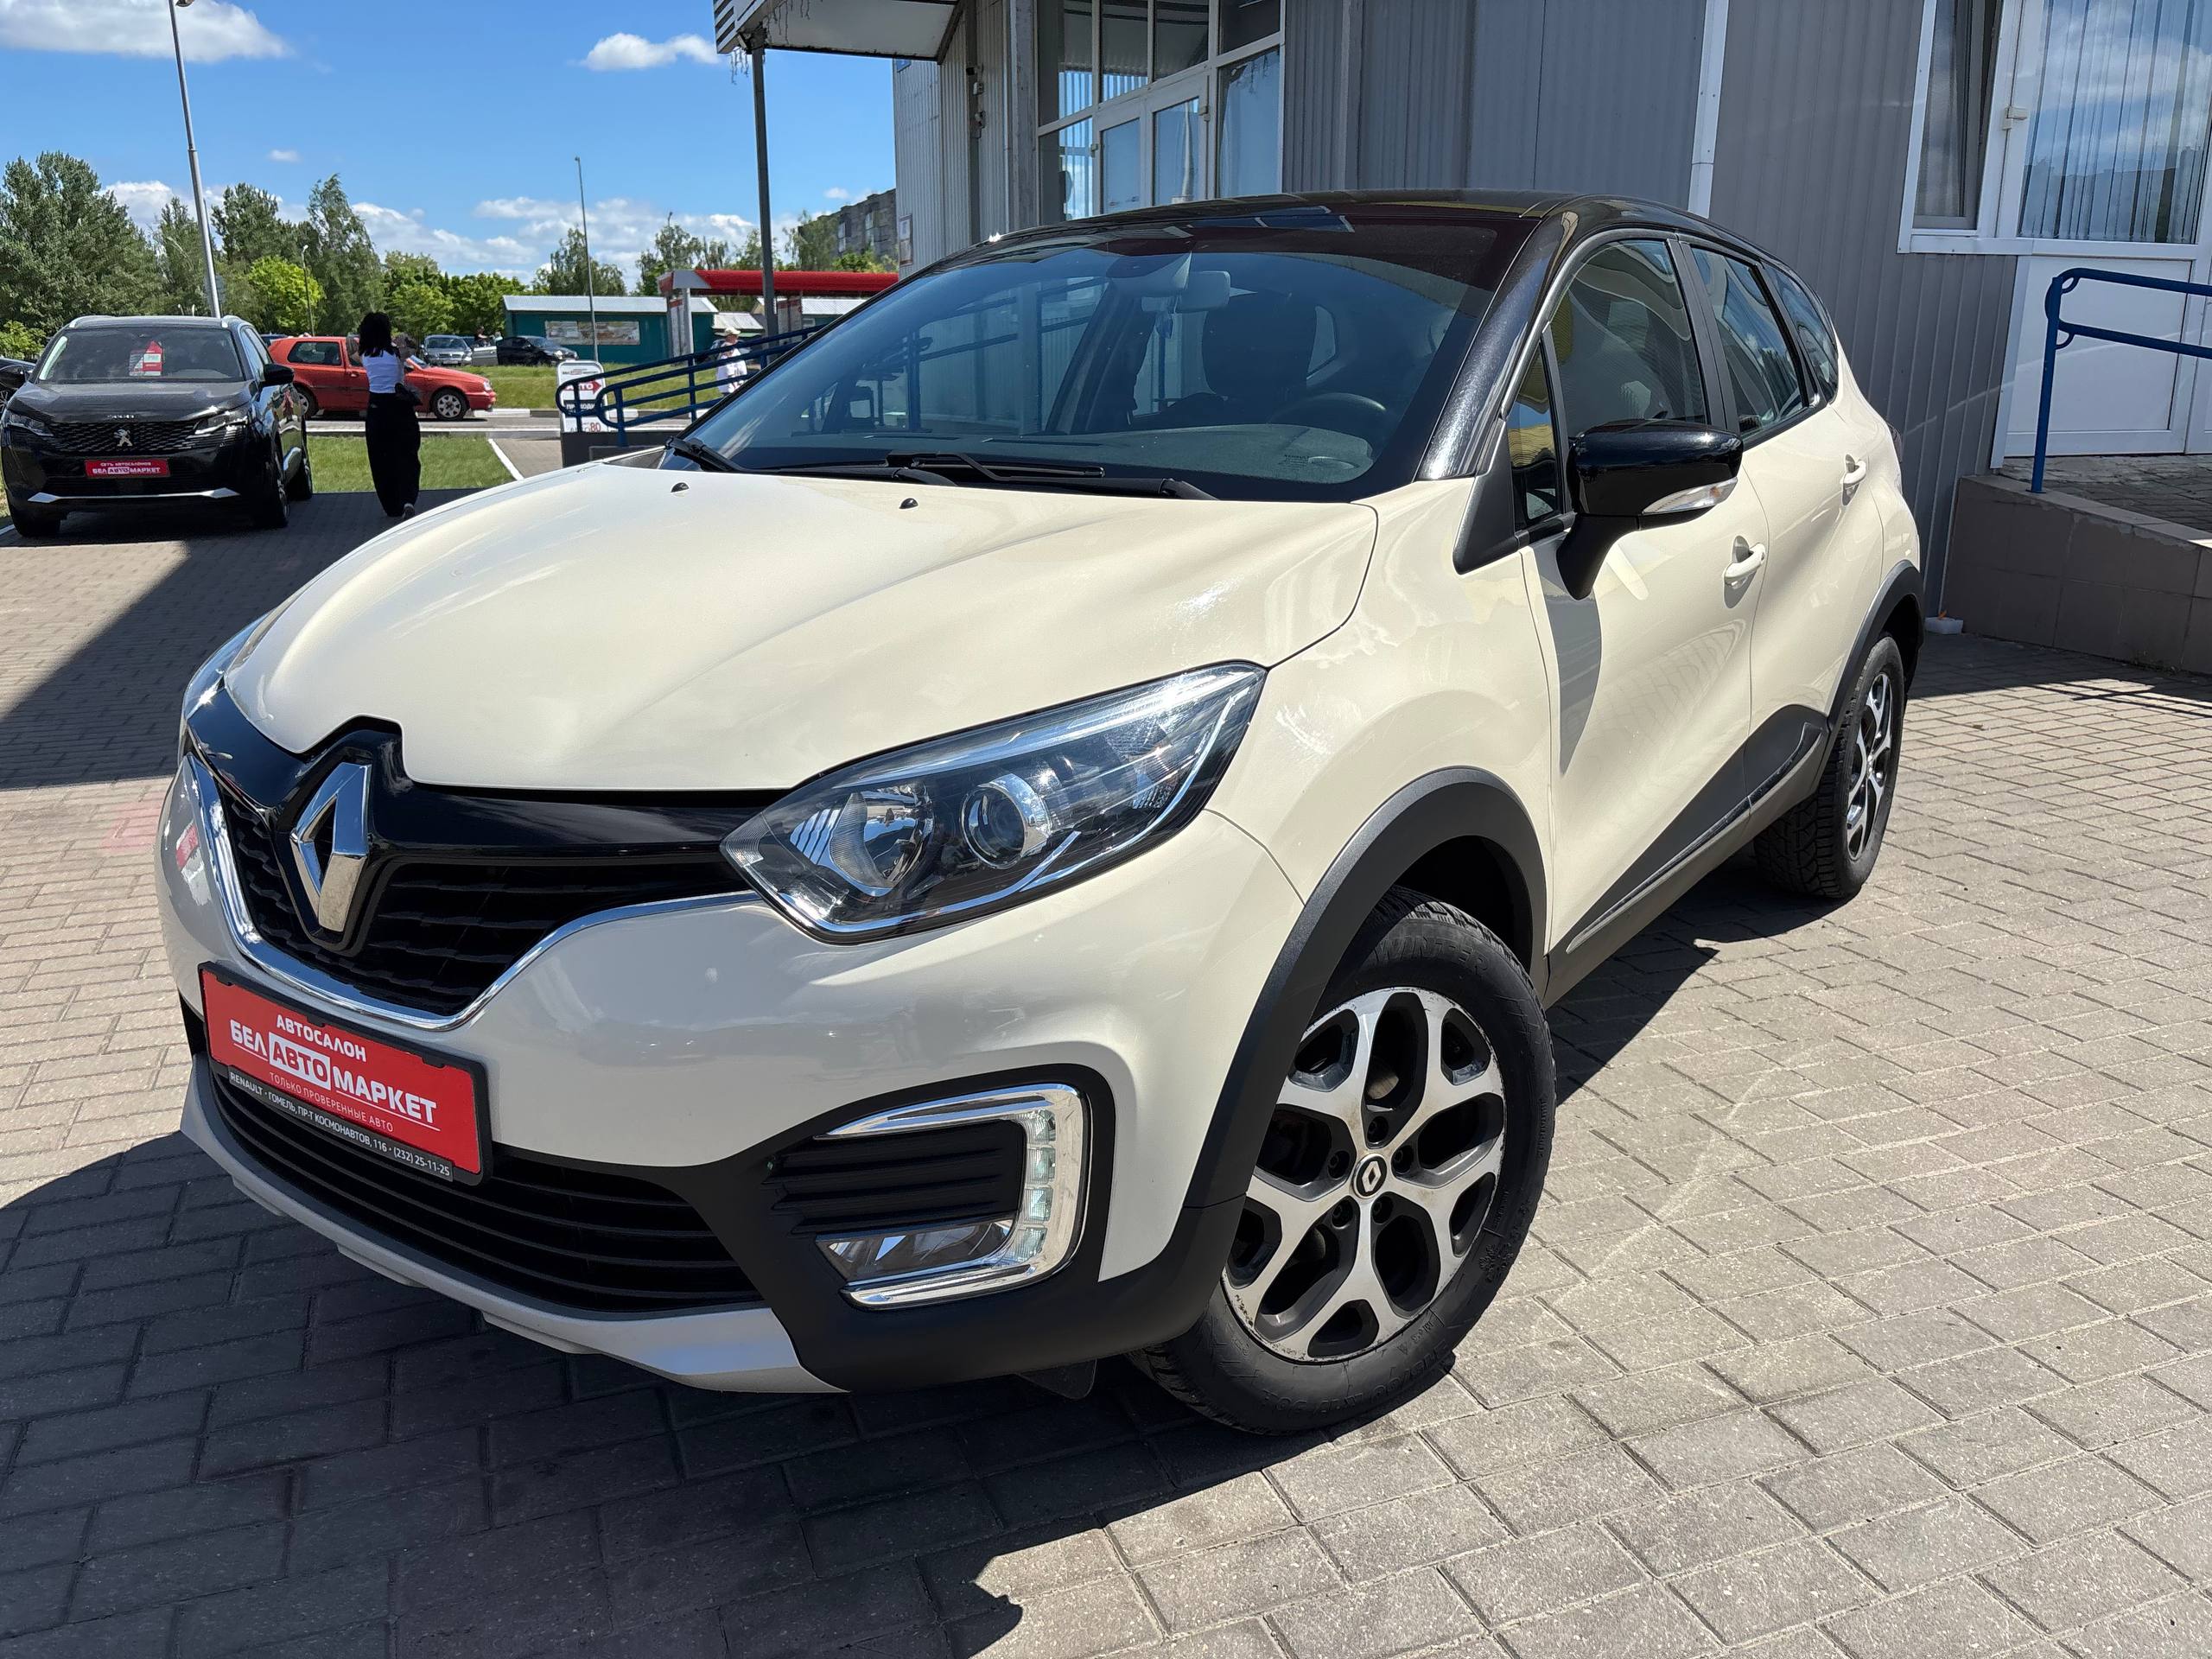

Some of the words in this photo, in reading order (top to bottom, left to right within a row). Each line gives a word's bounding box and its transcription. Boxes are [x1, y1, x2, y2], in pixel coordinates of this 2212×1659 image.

[276, 1014, 367, 1063] АВТОСАЛОН
[229, 1071, 264, 1096] RENAULT
[314, 1114, 372, 1147] КОСМОНАВТОВ,
[372, 1139, 388, 1153] 116
[393, 1147, 415, 1164] (232)
[415, 1155, 450, 1176] 25-11-25
[269, 1071, 302, 1094] ТОЛЬКО
[302, 1087, 368, 1122] ПРОВЕРЕННЫЕ
[368, 1116, 394, 1133] АВТО
